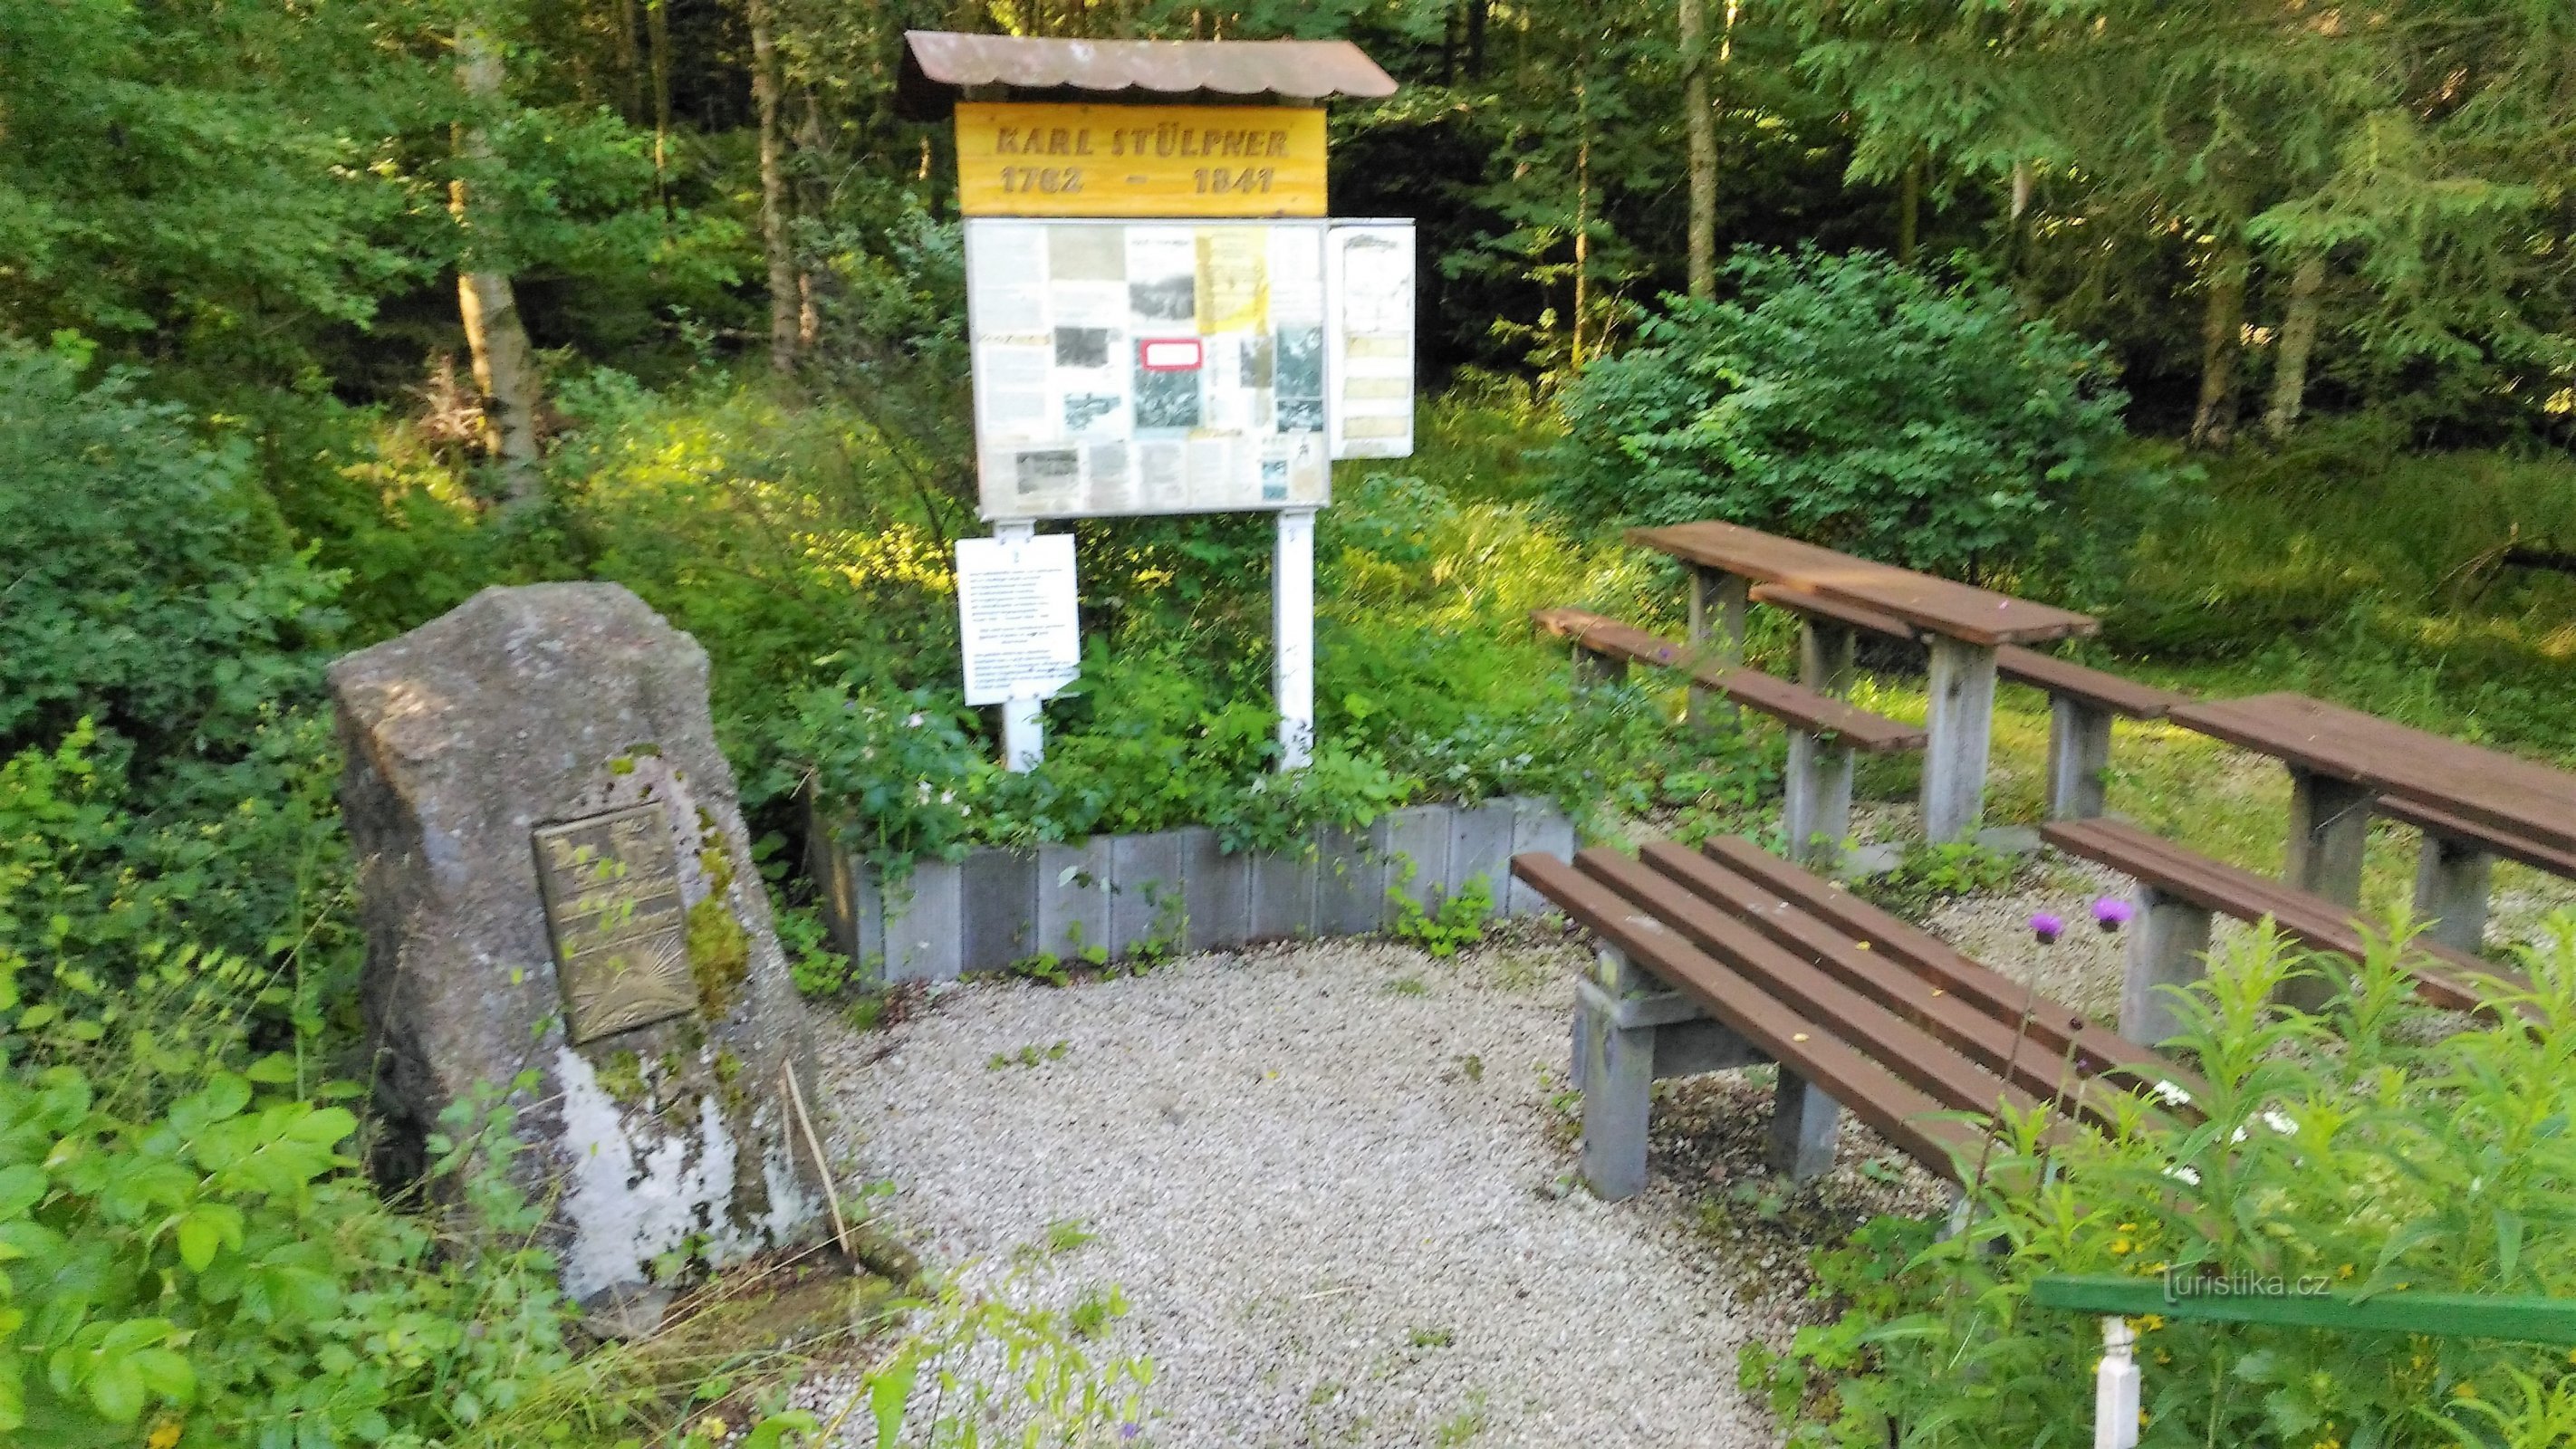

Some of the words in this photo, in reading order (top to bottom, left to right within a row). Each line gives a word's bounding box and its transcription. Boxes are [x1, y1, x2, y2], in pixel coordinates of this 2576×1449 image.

[996, 127, 1094, 156] KARL
[1111, 122, 1289, 158] STÜLPNER
[1194, 167, 1275, 195] 1841
